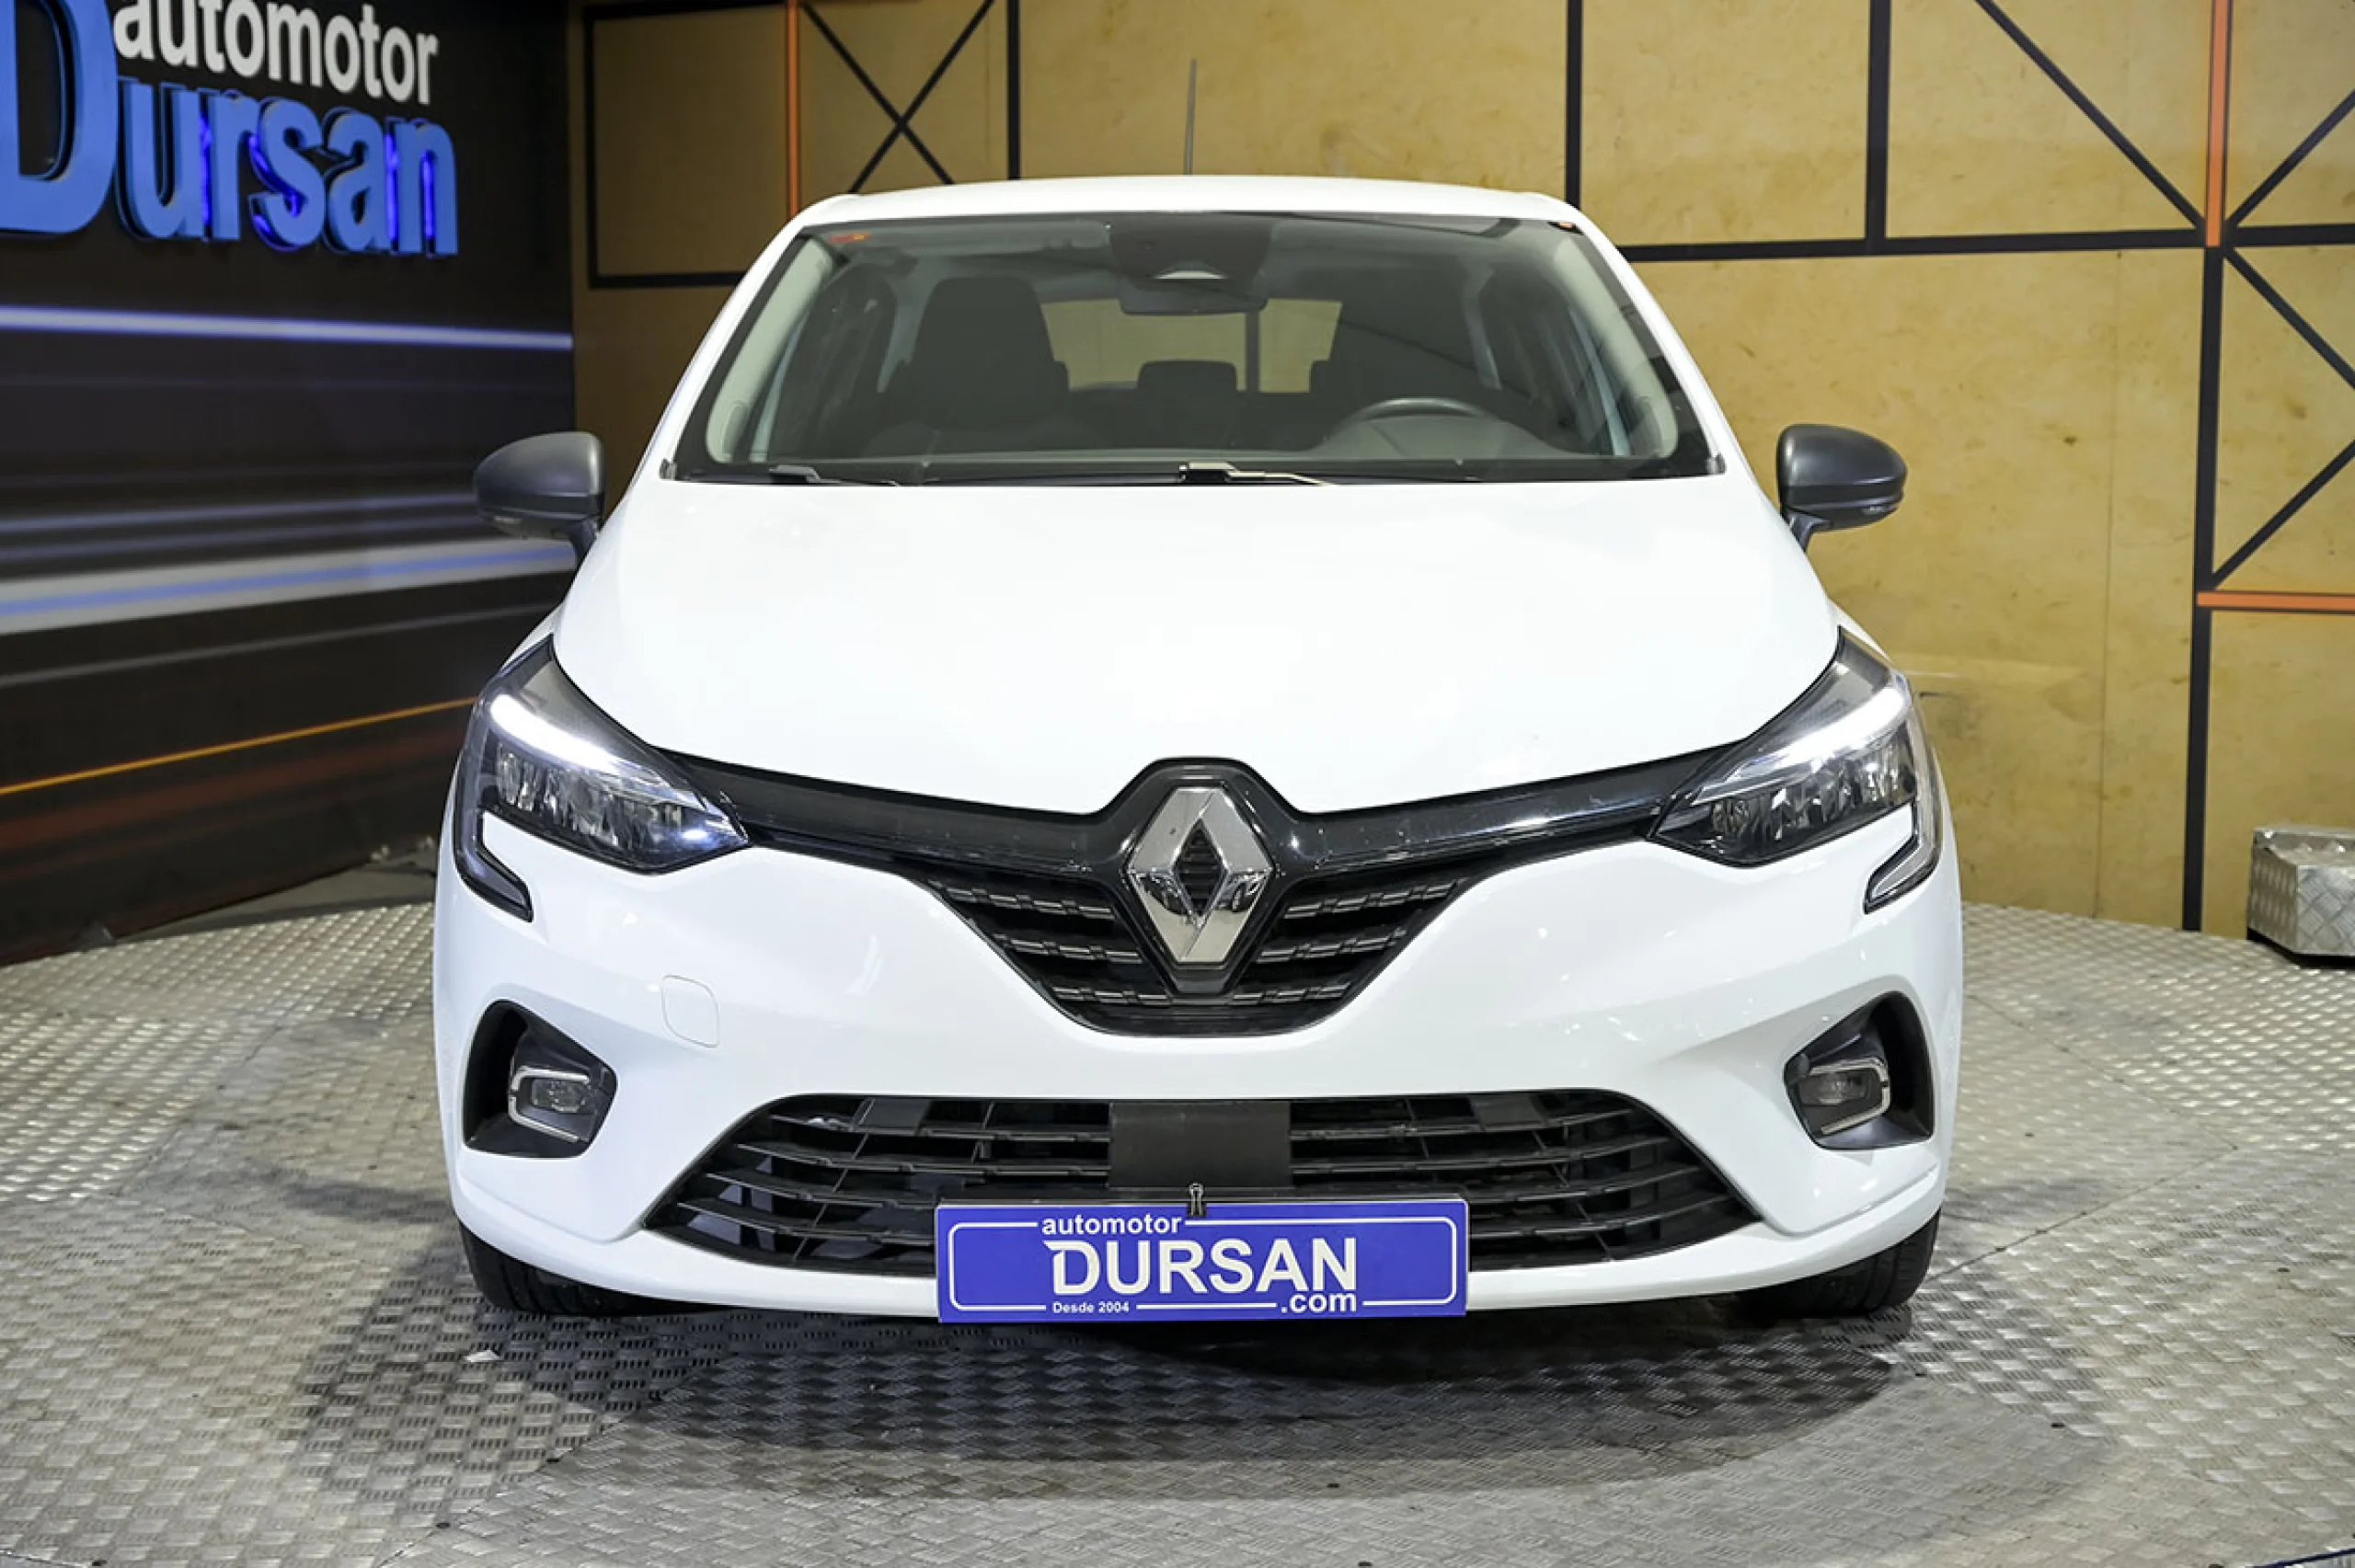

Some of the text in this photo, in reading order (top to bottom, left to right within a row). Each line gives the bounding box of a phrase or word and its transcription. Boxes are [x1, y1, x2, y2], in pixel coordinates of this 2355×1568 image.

[113, 0, 439, 105] automotor
[0, 0, 458, 256] Dursan
[1041, 1214, 1182, 1235] automotor
[1043, 1238, 1357, 1295] DURSAN
[1052, 1301, 1130, 1313] Desde 2004
[1281, 1292, 1357, 1313] .com
